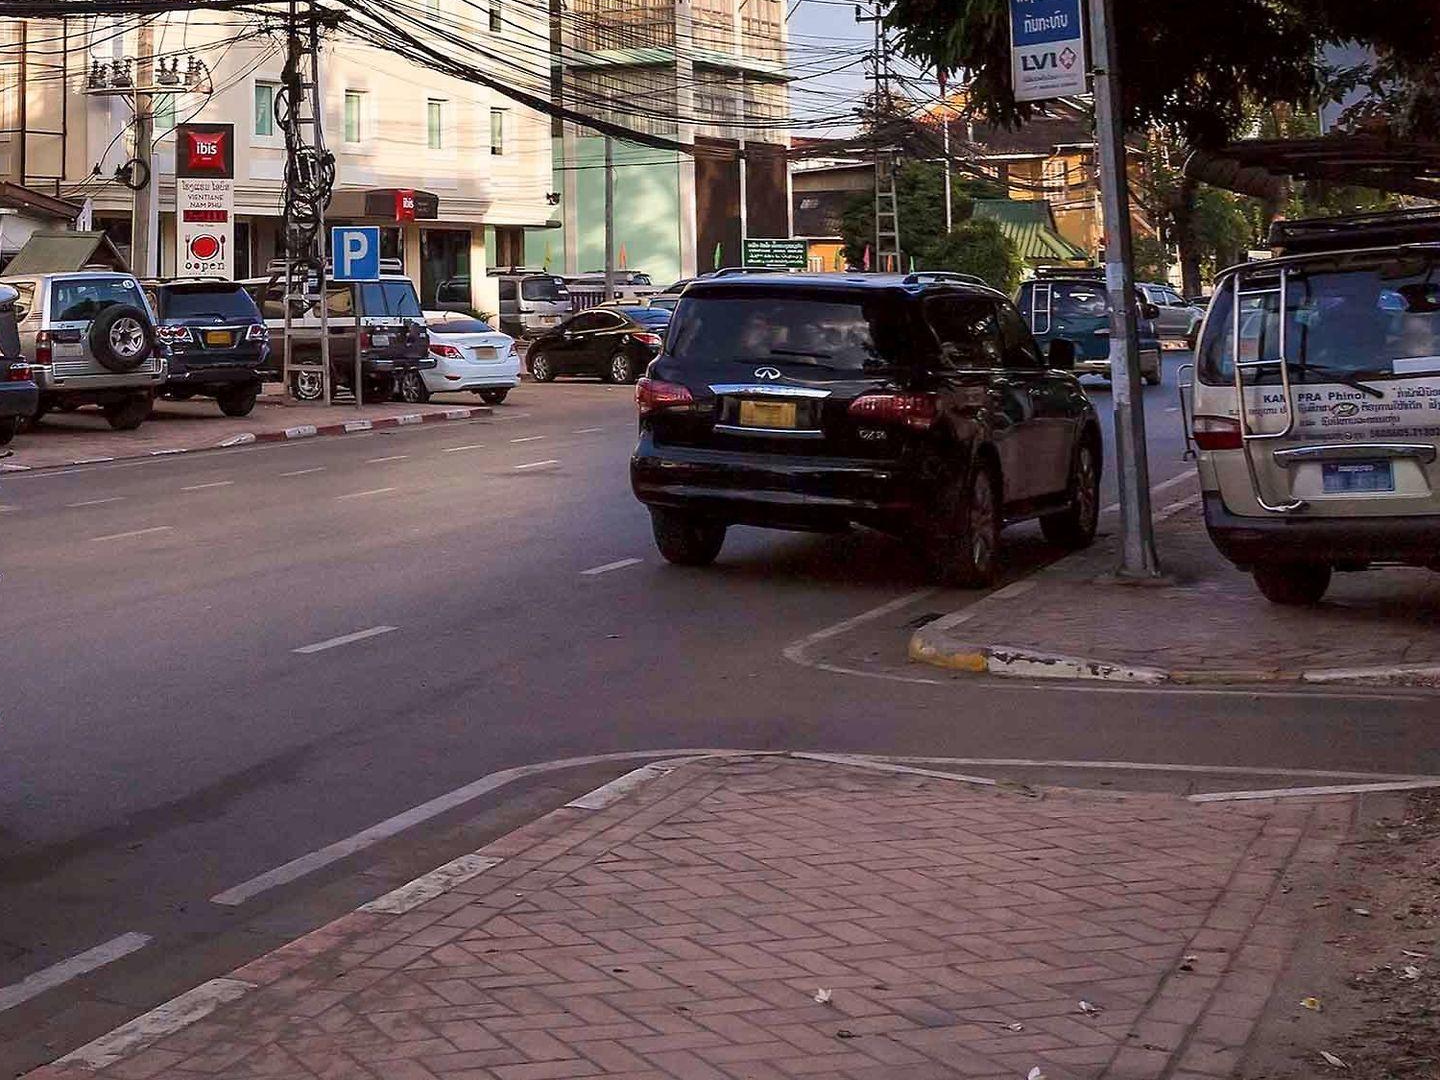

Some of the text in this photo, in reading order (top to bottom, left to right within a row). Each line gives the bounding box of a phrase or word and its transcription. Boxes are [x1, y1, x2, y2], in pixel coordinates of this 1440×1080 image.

[1021, 52, 1058, 71] LVI
[196, 142, 217, 155] ibis
[343, 231, 369, 277] P
[1298, 393, 1322, 402] PRA
